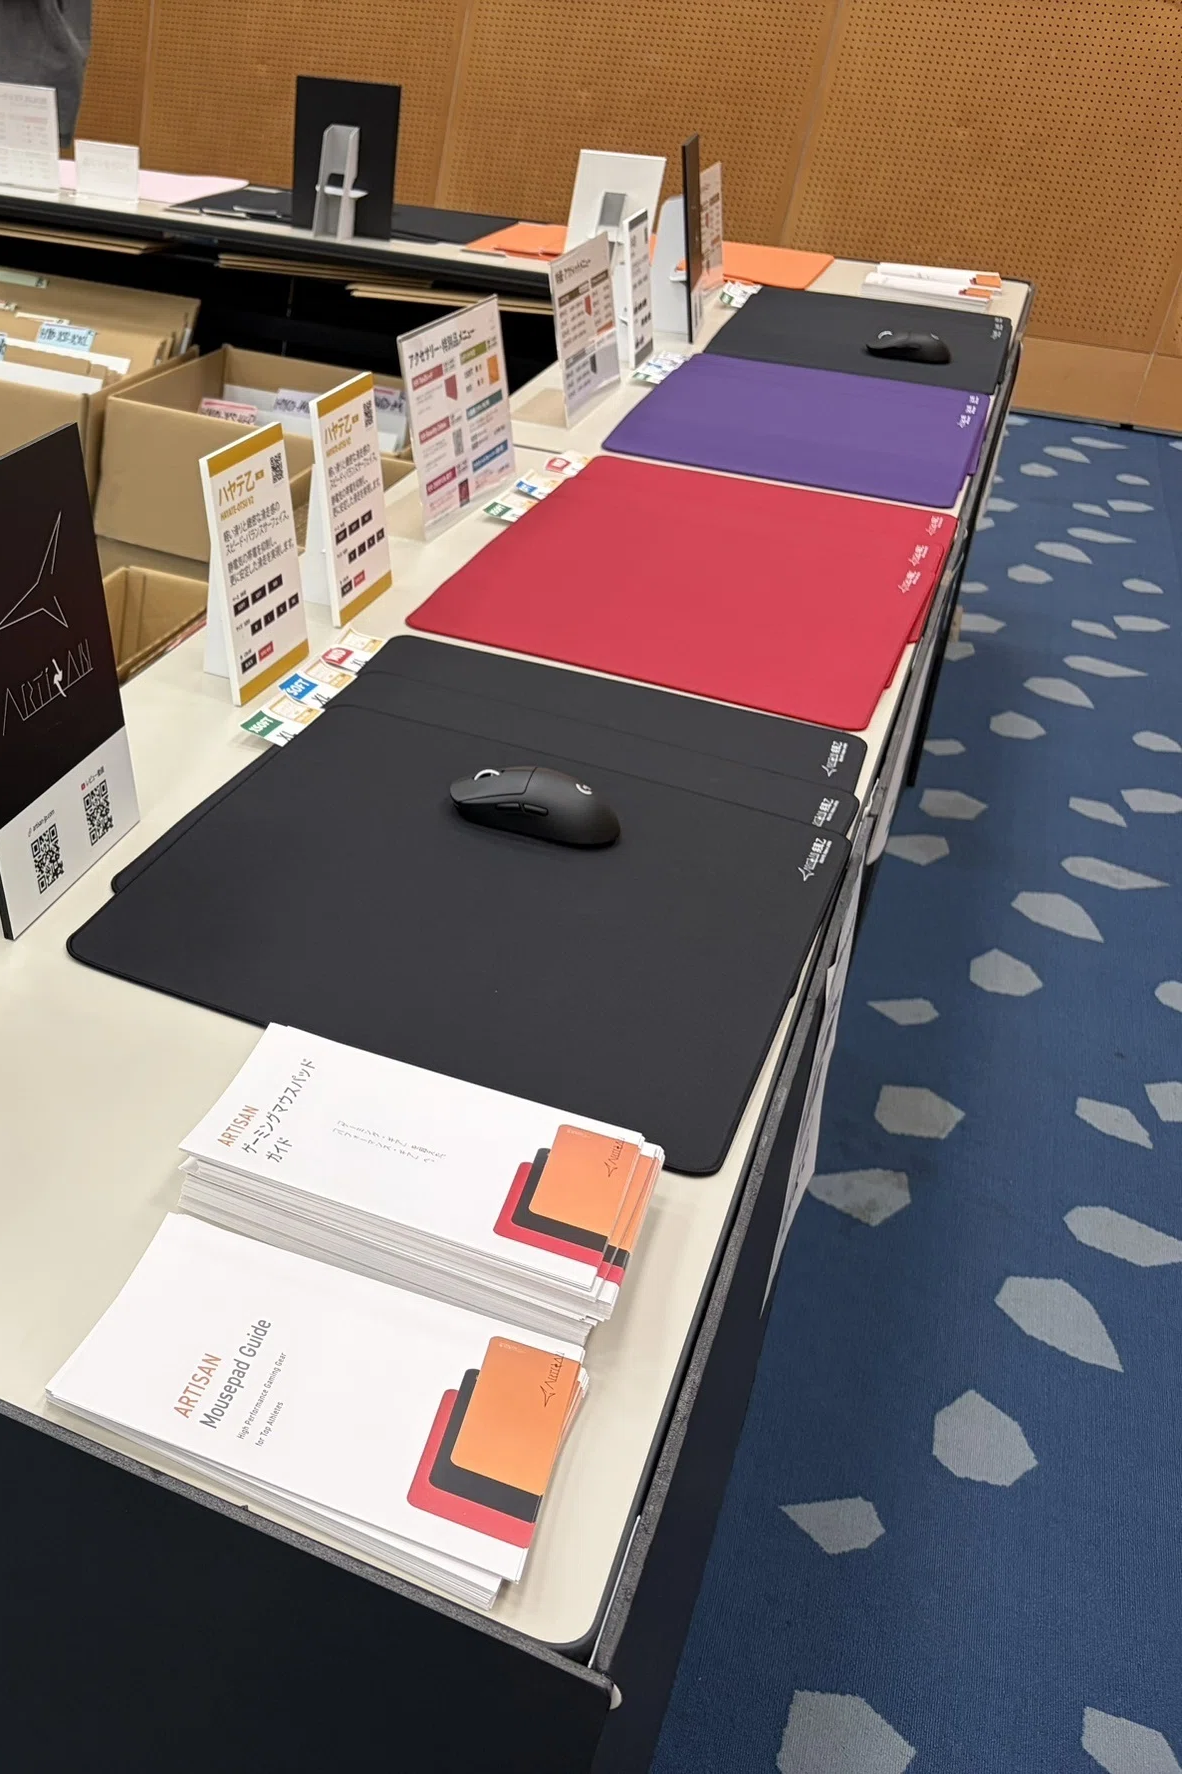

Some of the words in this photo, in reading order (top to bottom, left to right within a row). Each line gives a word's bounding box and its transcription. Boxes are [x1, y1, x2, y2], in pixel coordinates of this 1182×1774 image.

[324, 414, 352, 444] ハヤテ乙
[219, 470, 255, 506] ハヤテ乙
[286, 678, 310, 696] SOFT
[248, 717, 274, 734] XSOFT
[241, 1058, 316, 1154] ゲーミングマウスパッド
[217, 1104, 259, 1147] ARTISAN
[266, 1136, 293, 1163] ガイド
[173, 1353, 222, 1419] ARTISAN
[199, 1358, 251, 1429] Mousepad
[238, 1319, 272, 1358] Guide
[237, 1425, 250, 1440] High
[244, 1390, 269, 1426] Performance
[264, 1366, 282, 1389] Gaming
[274, 1352, 287, 1368] Gear
[266, 1401, 284, 1426] Athletes
[255, 1437, 265, 1447] for
[259, 1425, 273, 1438] Top
